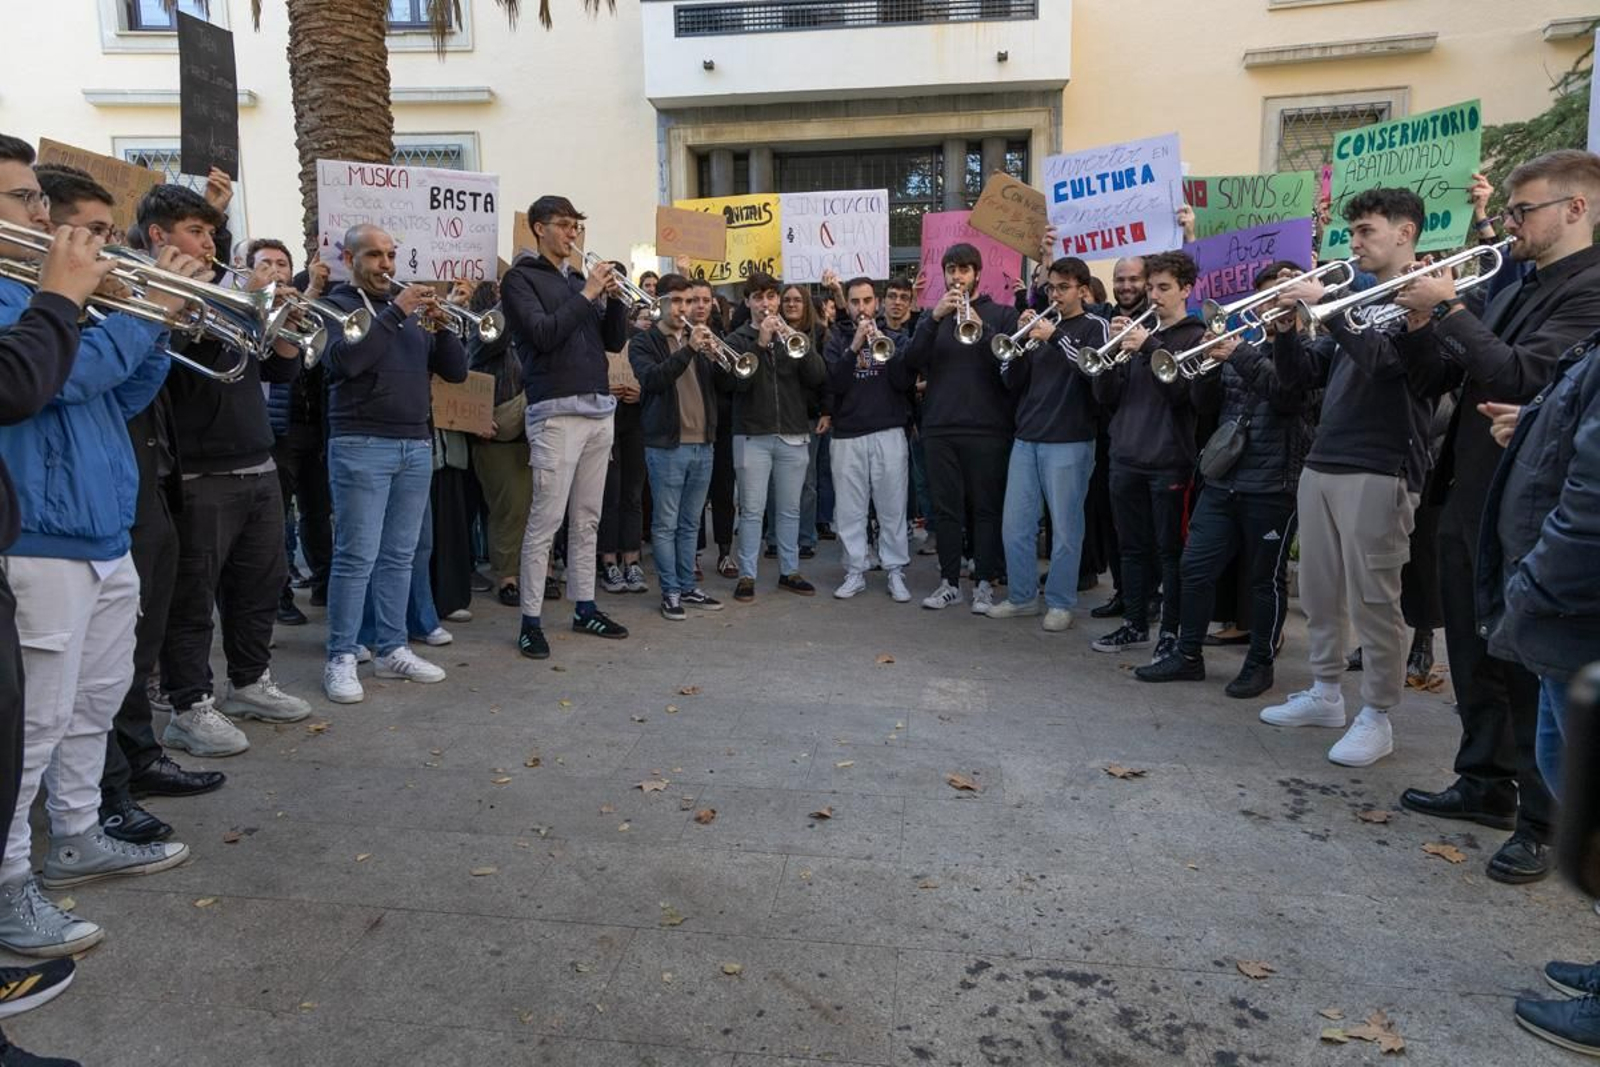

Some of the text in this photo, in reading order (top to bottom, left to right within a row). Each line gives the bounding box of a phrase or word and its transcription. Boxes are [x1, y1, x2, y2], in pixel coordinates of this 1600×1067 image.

[1336, 106, 1479, 160] CONSERVATORIO
[1152, 146, 1169, 159] EN
[1344, 140, 1455, 183] ABANDONADO
[1054, 163, 1155, 203] CULTURA
[1182, 180, 1207, 208] NO
[1217, 174, 1277, 210] SOMOS
[1282, 179, 1303, 208] el
[430, 186, 495, 213] BASTA
[788, 198, 818, 216] SIN
[435, 216, 463, 239] NO
[842, 220, 877, 246] HAY
[1062, 221, 1147, 255] FUTURO
